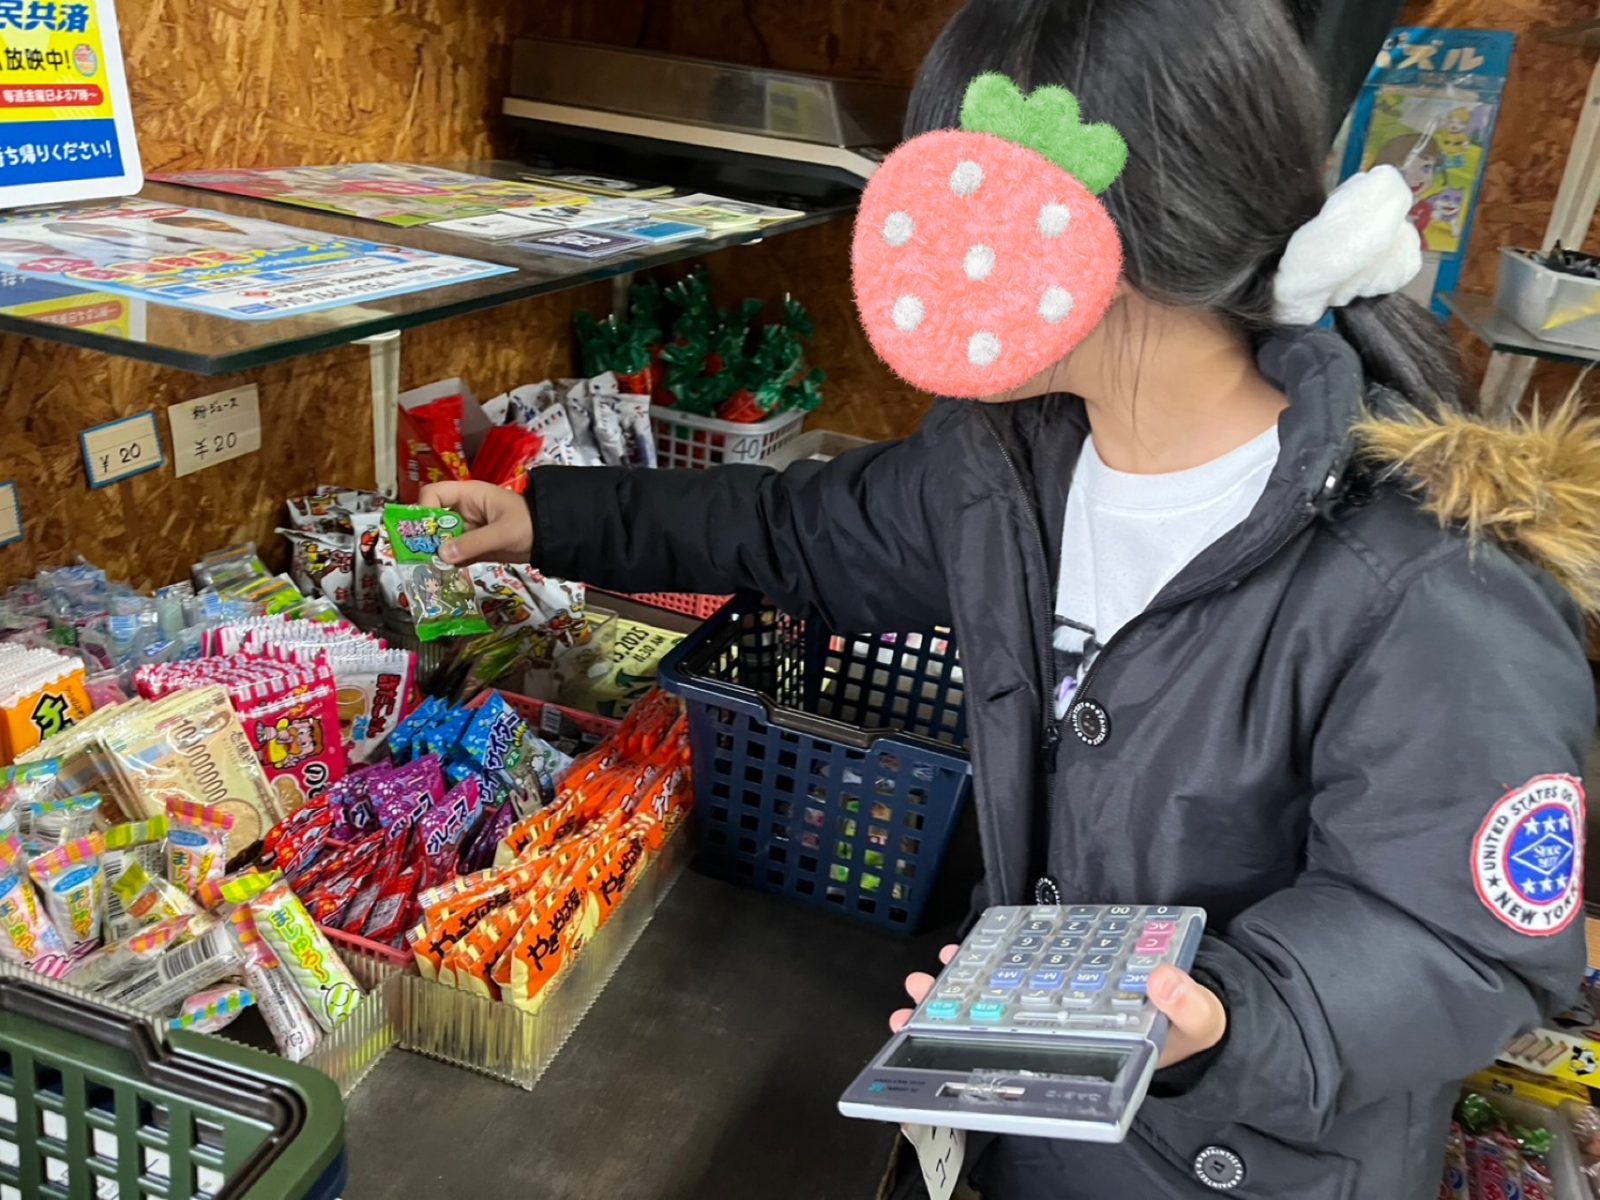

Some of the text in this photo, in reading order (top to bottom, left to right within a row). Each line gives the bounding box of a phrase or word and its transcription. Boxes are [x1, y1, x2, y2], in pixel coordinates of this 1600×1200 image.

[0, 47, 71, 72] 放映中!
[732, 438, 760, 461] 40
[1510, 786, 1558, 816] STATES
[1483, 815, 1509, 871] UNITED
[1111, 906, 1131, 914] 00
[1494, 891, 1536, 926] NEW
